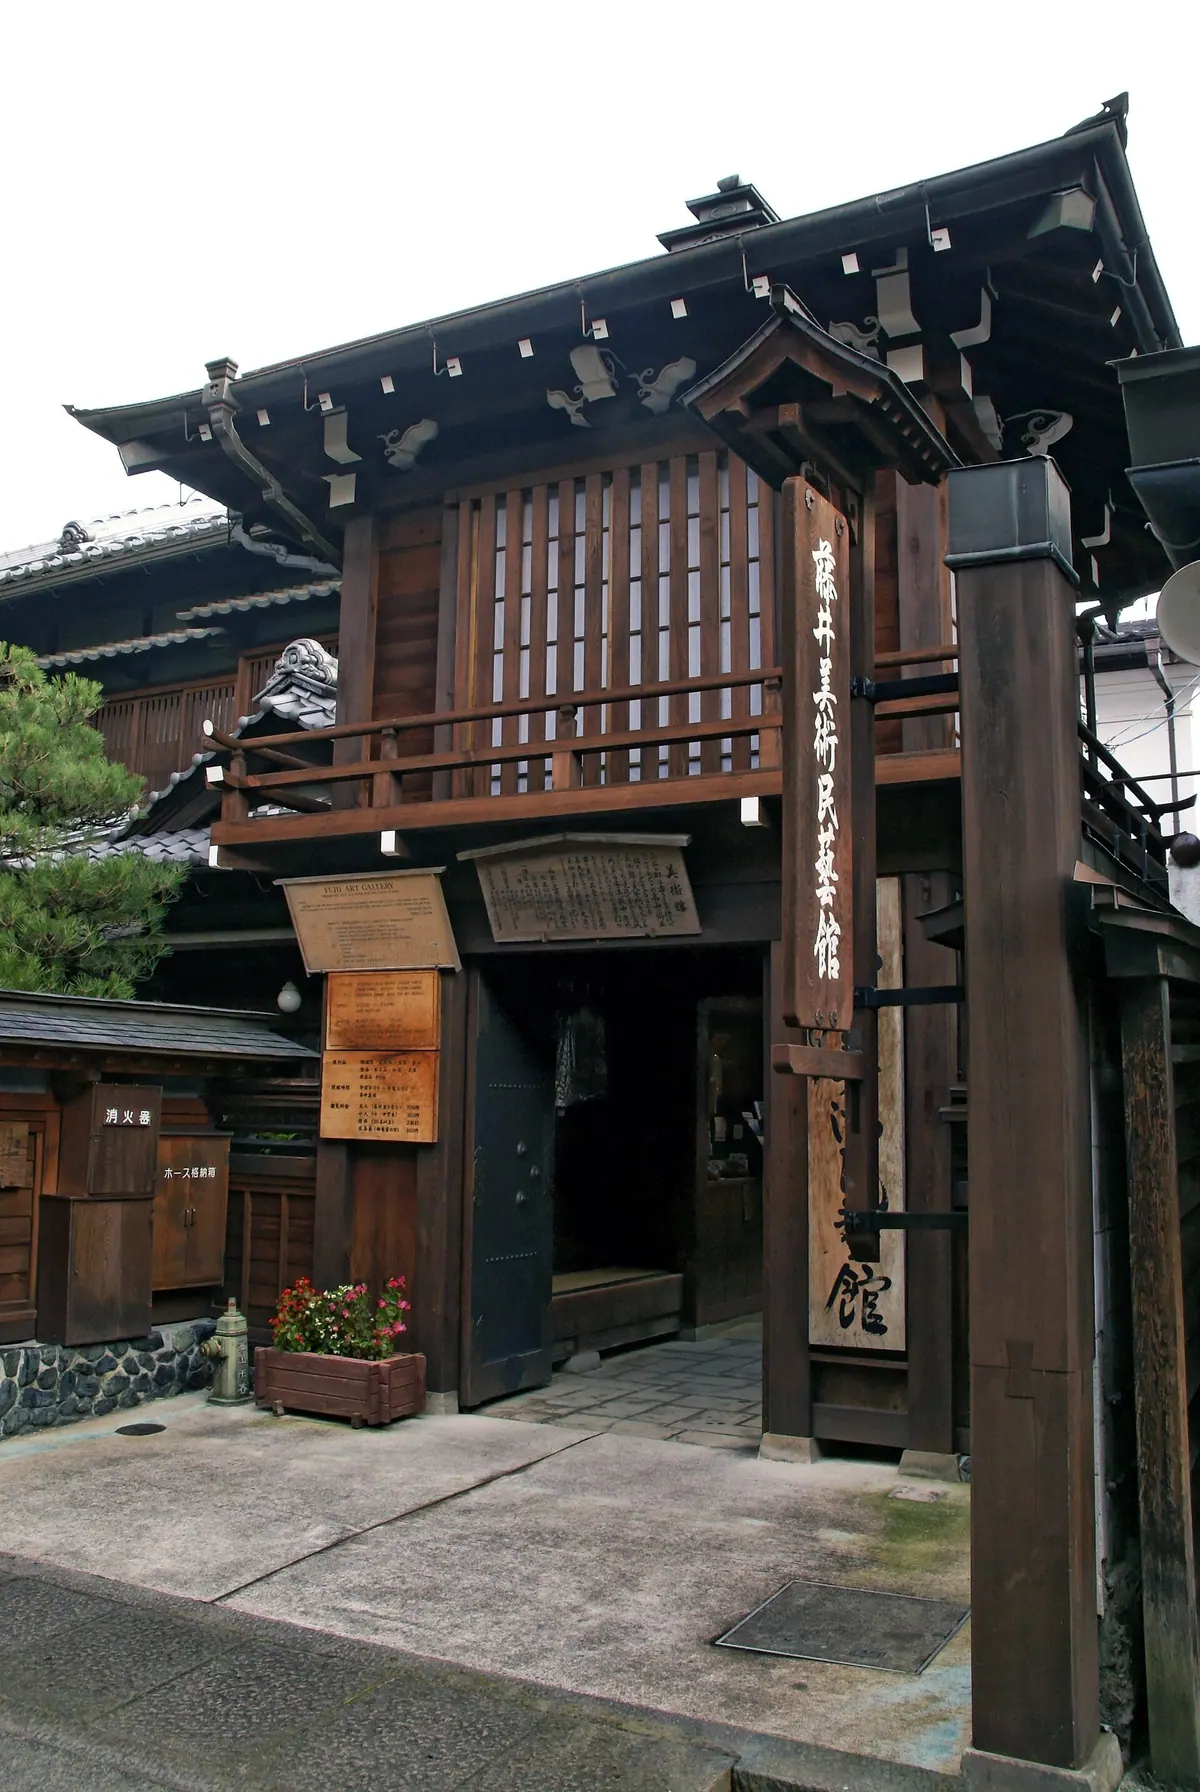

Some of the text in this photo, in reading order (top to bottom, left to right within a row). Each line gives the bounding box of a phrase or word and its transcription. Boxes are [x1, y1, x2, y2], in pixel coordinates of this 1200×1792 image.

[361, 882, 394, 891] GALLERY
[105, 1108, 151, 1125] 消火器
[163, 1167, 216, 1179] ホース格納箱
